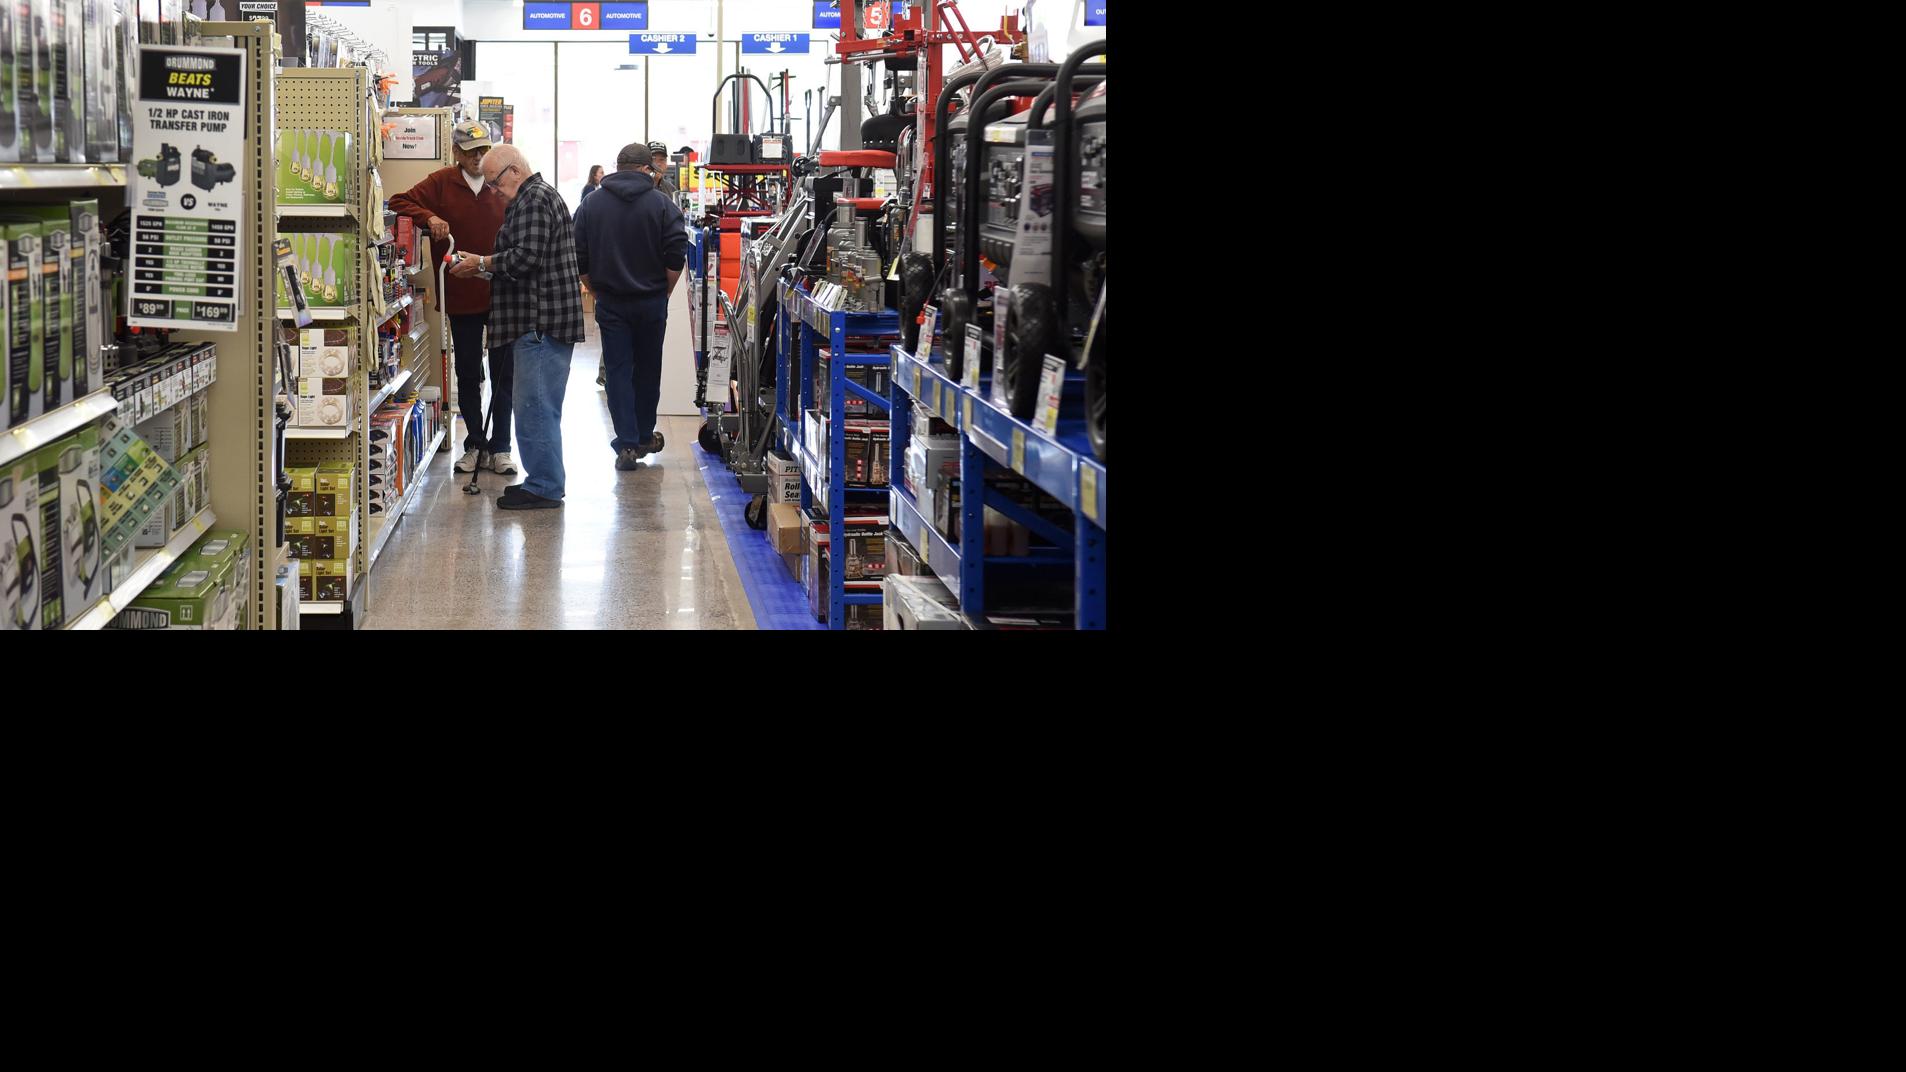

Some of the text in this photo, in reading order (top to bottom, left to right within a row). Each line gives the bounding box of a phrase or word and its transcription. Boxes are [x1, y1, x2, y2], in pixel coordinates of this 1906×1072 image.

[579, 8, 592, 26] 6
[870, 8, 882, 24] 5
[640, 34, 685, 42] CASHIER 2
[753, 34, 797, 42] CASHIER 1
[166, 56, 215, 69] DRUMMOND
[168, 72, 212, 86] BEATS
[148, 108, 229, 121] 1/2 HP CAST IRON
[150, 120, 227, 132] TRANSFER PUMP
[183, 198, 193, 207] VS
